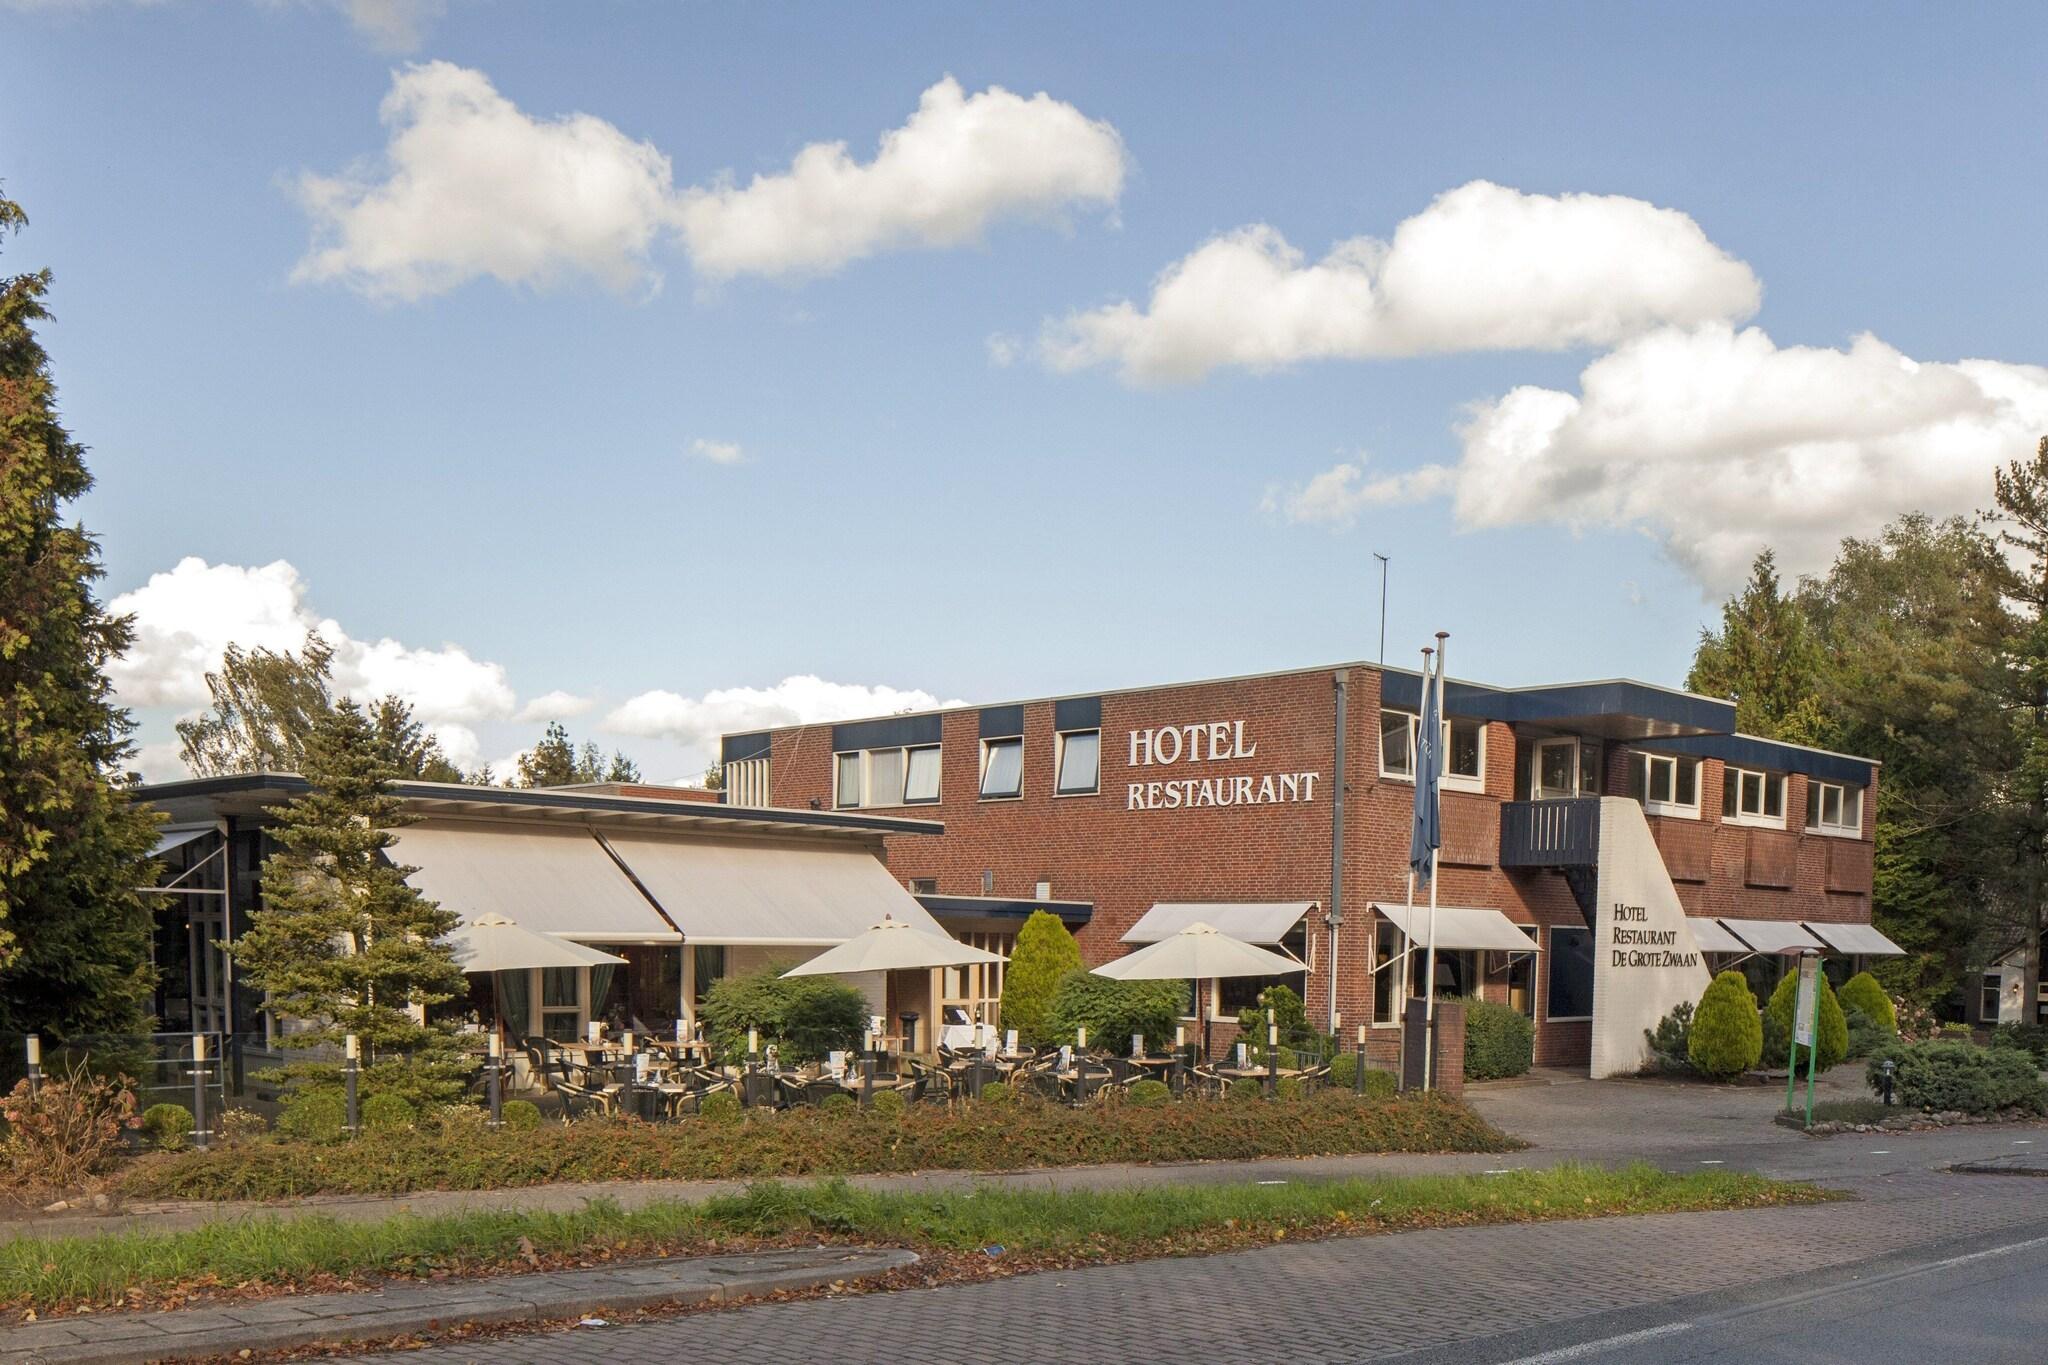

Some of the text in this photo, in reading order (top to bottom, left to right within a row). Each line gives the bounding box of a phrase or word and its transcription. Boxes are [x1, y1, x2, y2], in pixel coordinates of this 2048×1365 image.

[1128, 720, 1257, 766] HOTEL
[1127, 772, 1320, 811] RESTAURANT
[1613, 903, 1648, 922] HOTEL
[1612, 926, 1677, 945] RESTAURANT
[1611, 949, 1698, 968] DE GROTE ZWAAN
